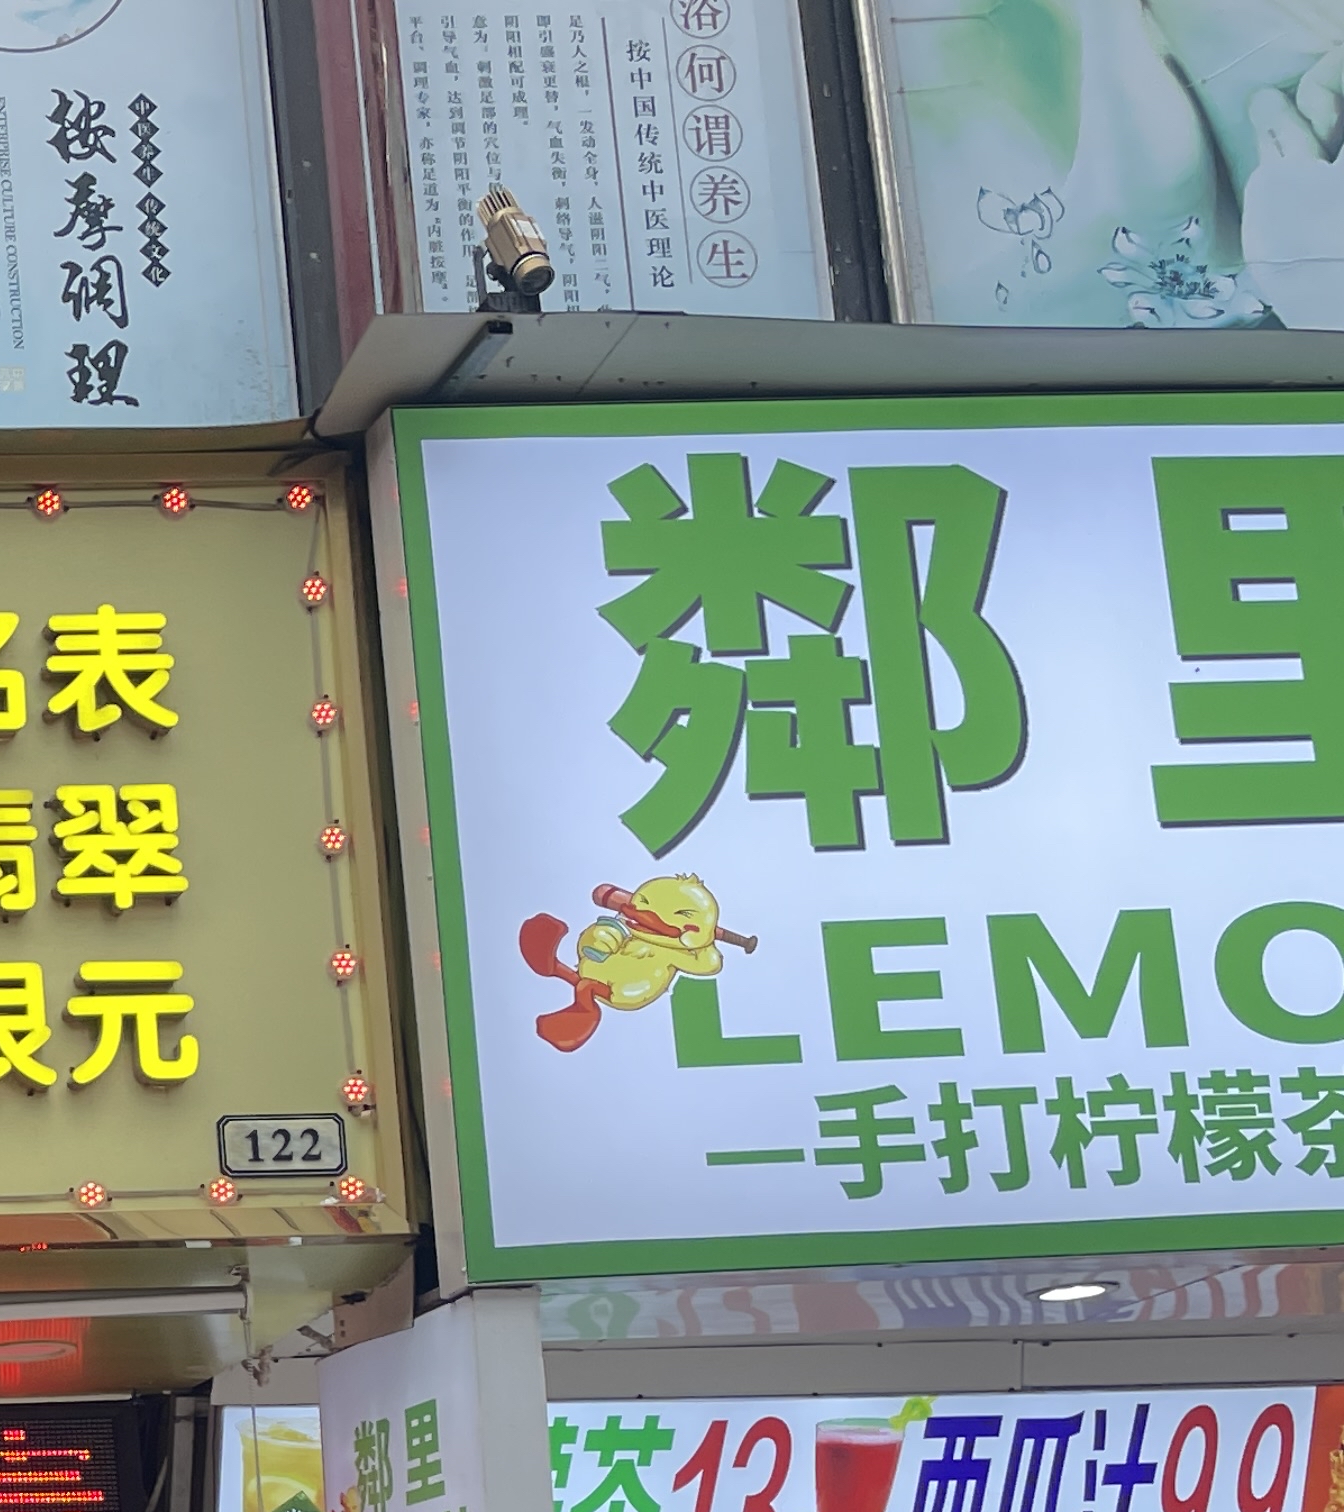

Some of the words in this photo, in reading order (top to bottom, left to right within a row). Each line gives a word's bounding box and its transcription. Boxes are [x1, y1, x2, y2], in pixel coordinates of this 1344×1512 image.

[625, 38, 677, 291] 按中国传统中医理论
[667, 902, 1344, 1070] LEMO
[245, 1126, 324, 1164] 122
